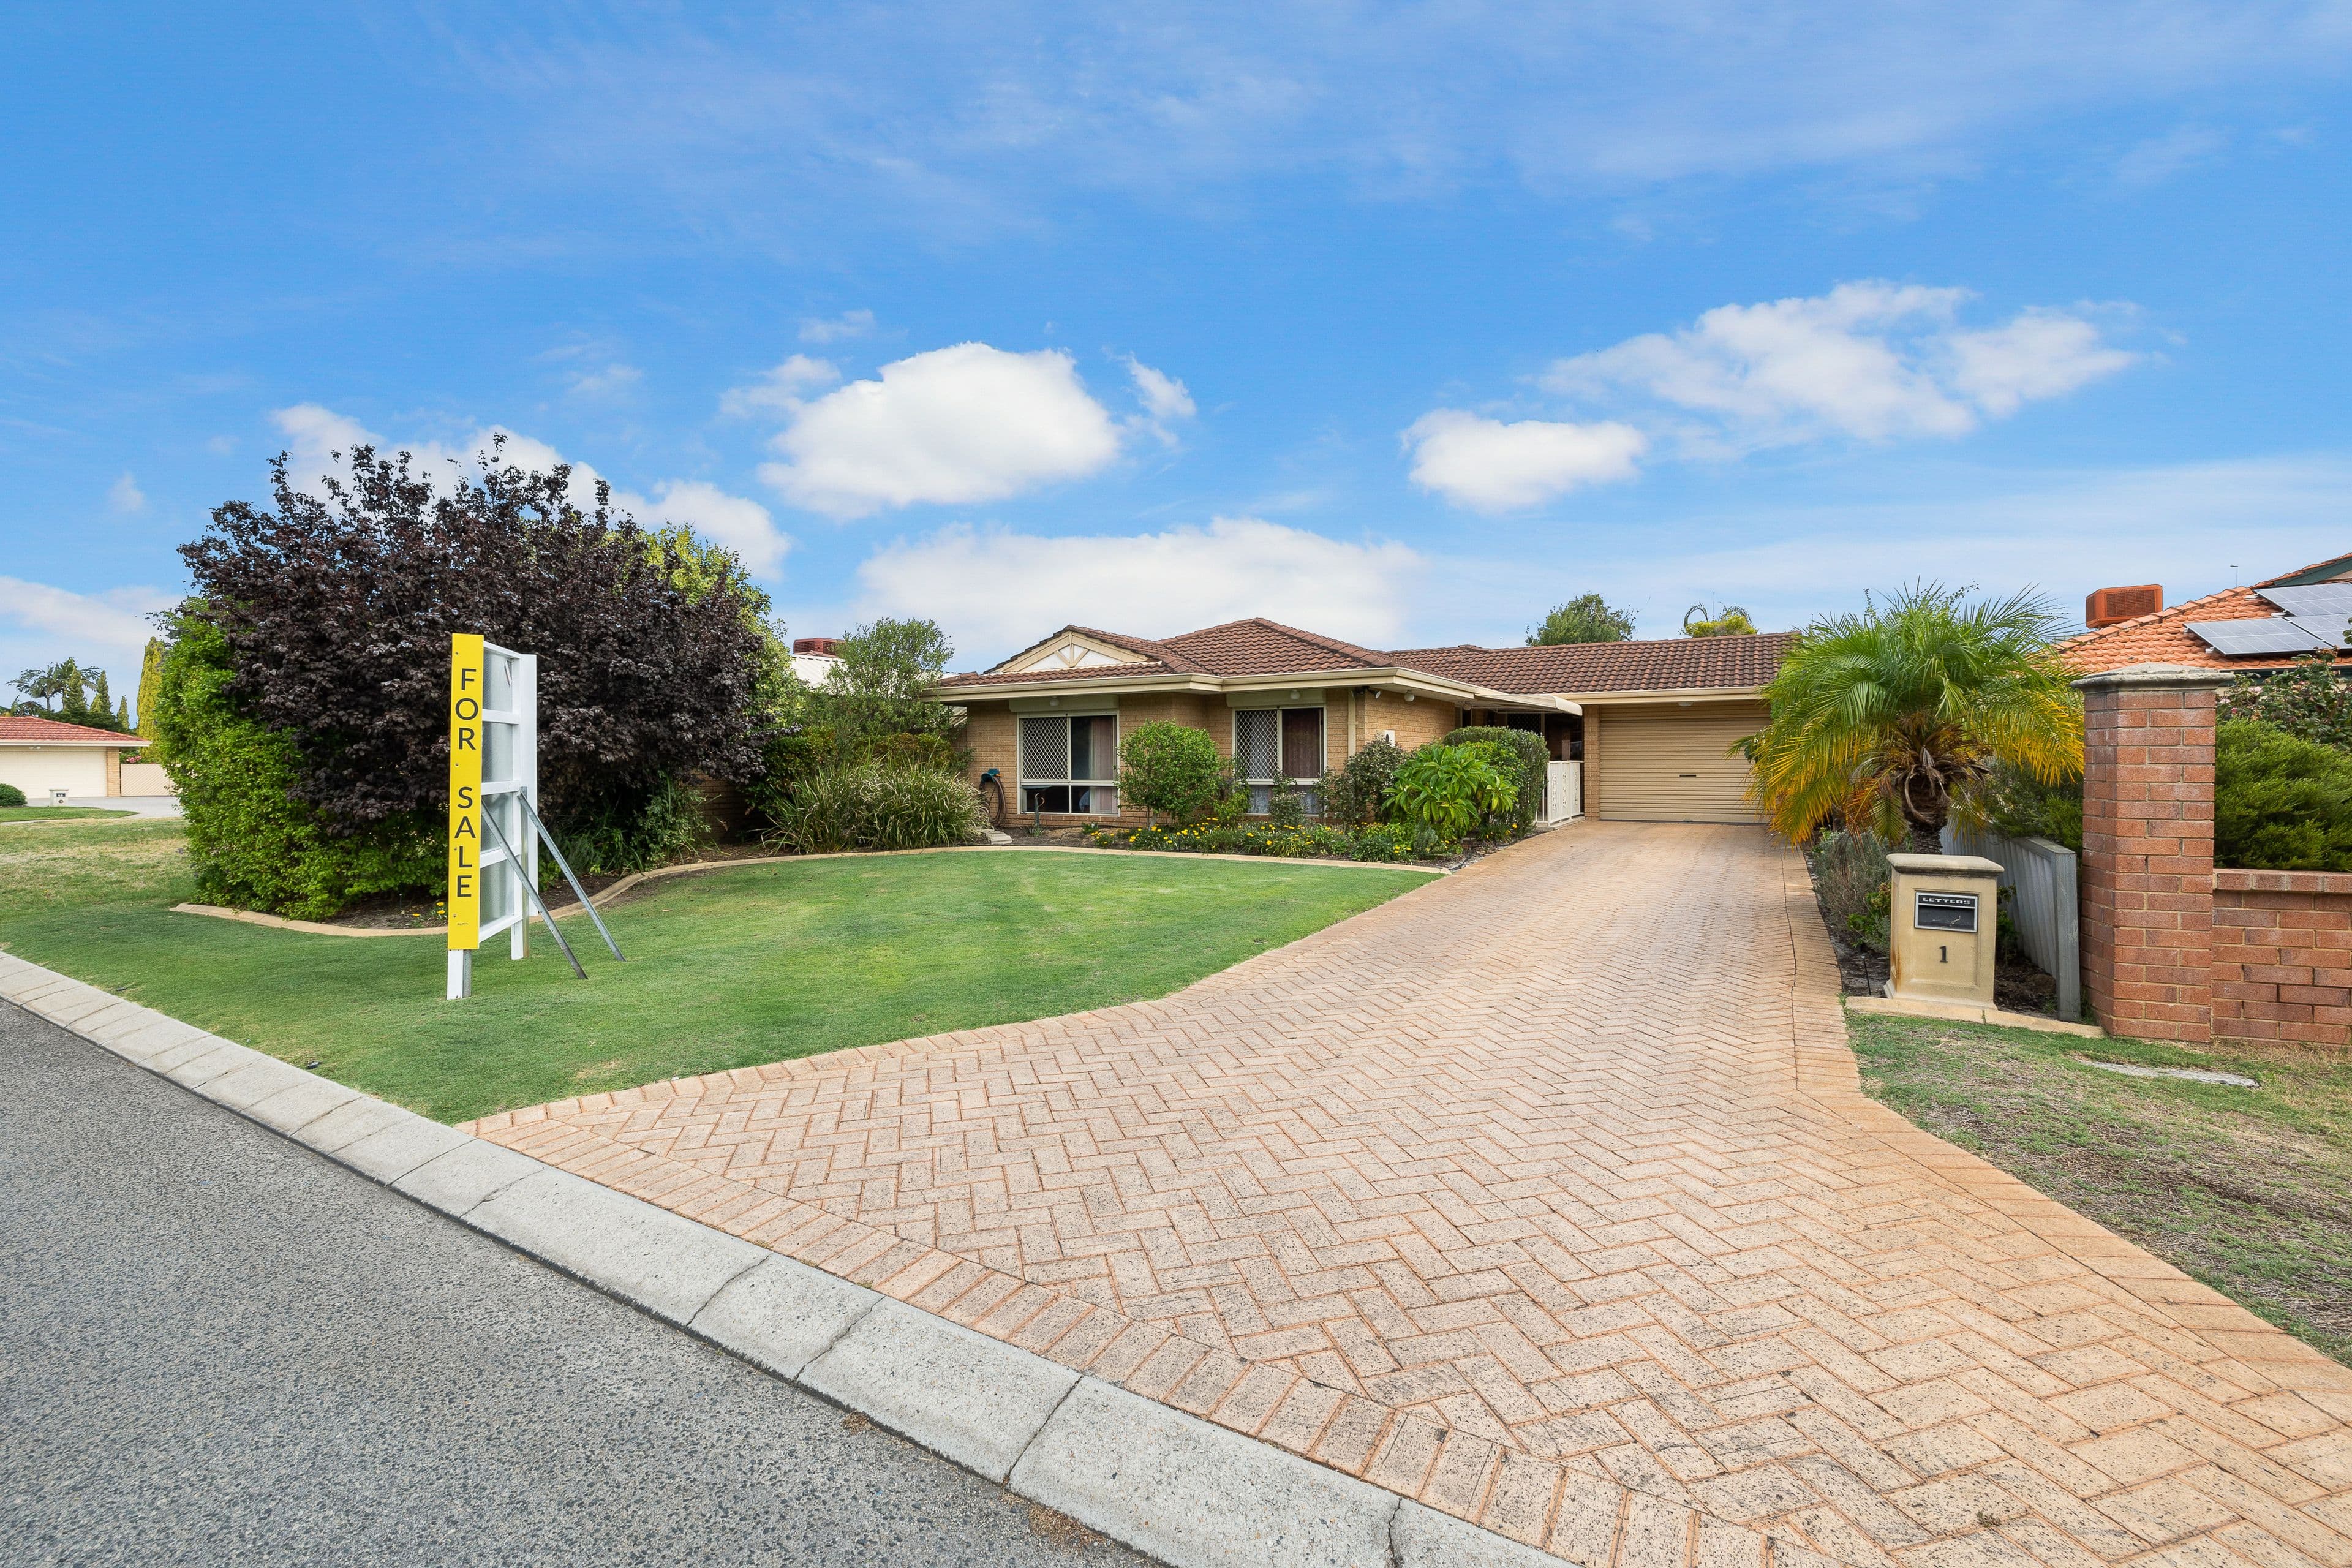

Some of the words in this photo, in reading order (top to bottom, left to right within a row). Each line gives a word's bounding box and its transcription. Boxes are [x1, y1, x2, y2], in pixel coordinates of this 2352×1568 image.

[455, 668, 478, 750] FOR
[454, 786, 476, 897] SALE
[1939, 946, 1948, 963] 1
